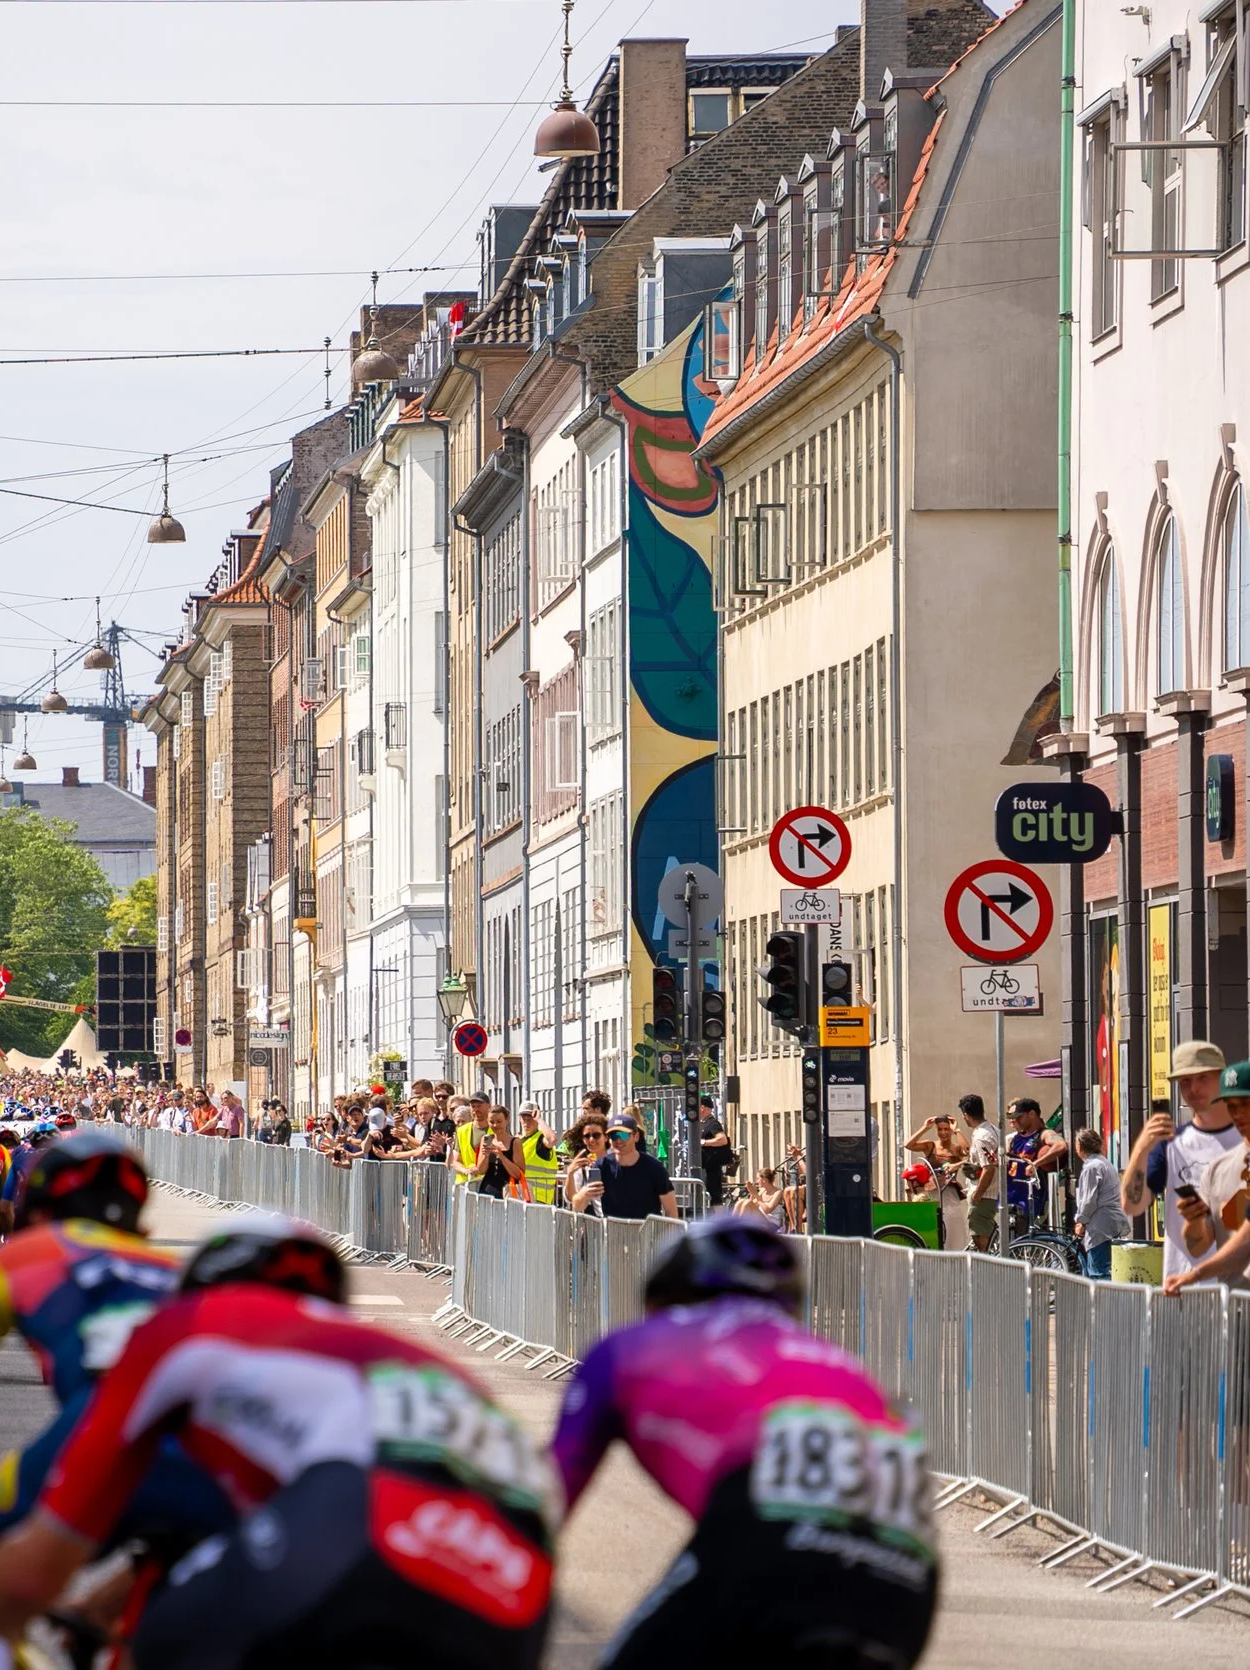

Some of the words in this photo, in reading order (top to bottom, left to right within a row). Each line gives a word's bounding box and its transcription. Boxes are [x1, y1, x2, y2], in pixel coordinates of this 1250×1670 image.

[1013, 797, 1047, 810] føtex
[1012, 801, 1094, 852] city
[789, 913, 832, 921] undtaget
[828, 1027, 838, 1035] 23
